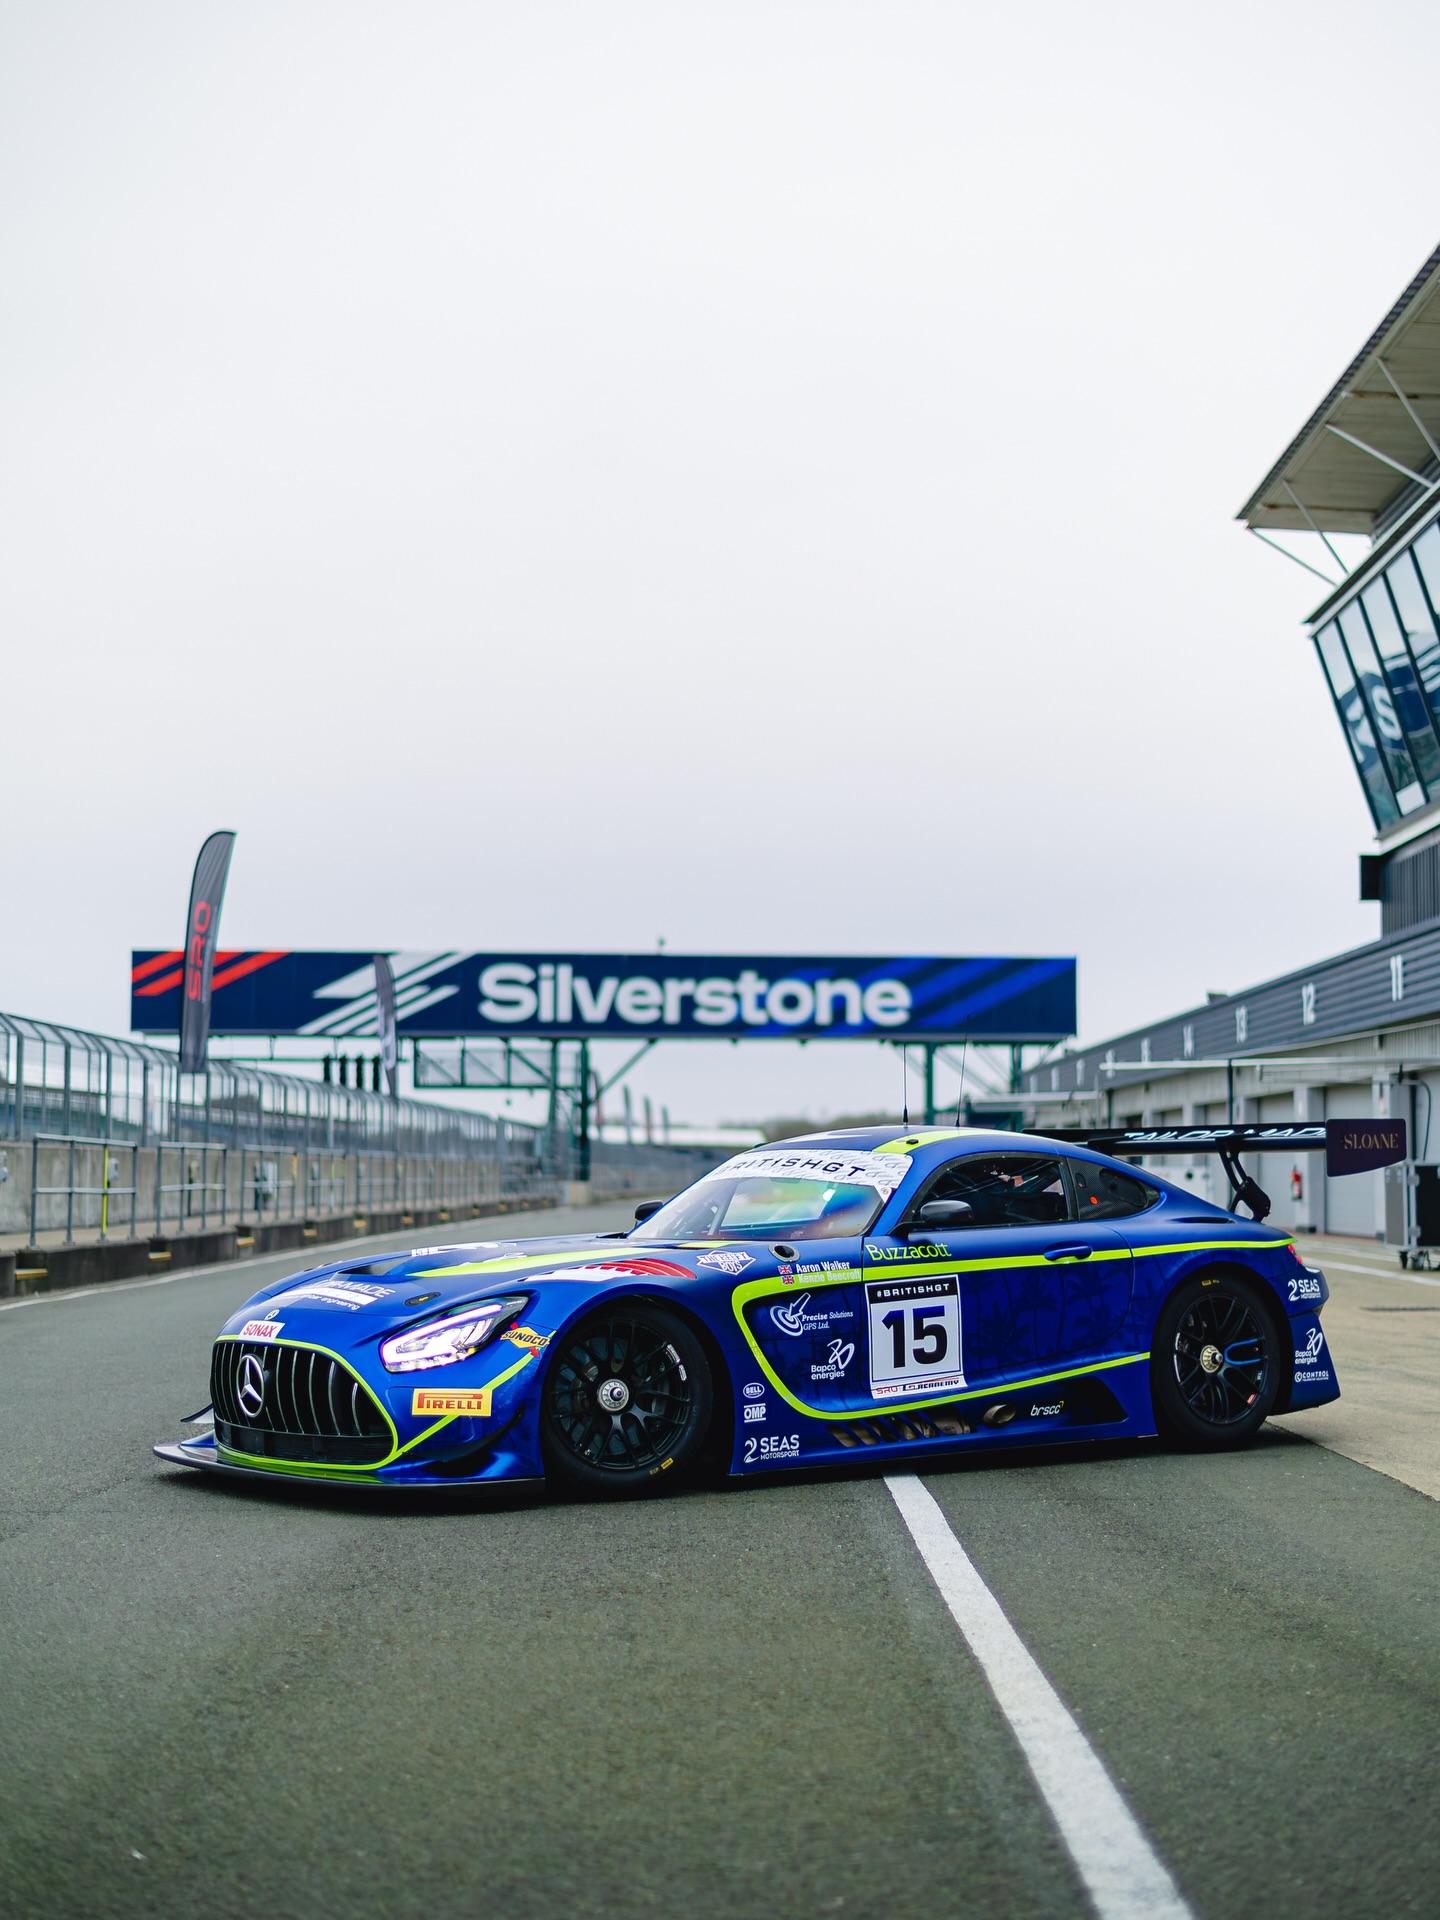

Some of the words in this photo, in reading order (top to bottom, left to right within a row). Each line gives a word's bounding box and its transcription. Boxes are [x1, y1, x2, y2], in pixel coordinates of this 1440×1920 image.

[187, 901, 212, 1000] SRO
[1390, 955, 1403, 1001] 11
[478, 963, 912, 1027] Silverstone
[1302, 983, 1316, 1025] 12
[1236, 1006, 1248, 1043] 13
[1343, 1133, 1399, 1149] SLOANE
[865, 1244, 952, 1261] Buzzacott
[795, 1263, 821, 1274] Aaron
[822, 1261, 851, 1271] Walker
[877, 1283, 950, 1298] #BRITISHGT
[1298, 1279, 1320, 1293] SEAS
[801, 1312, 827, 1322] Precise
[829, 1310, 854, 1320] Solutions
[243, 1323, 277, 1338] SONAX
[803, 1322, 817, 1331] GPS
[818, 1320, 830, 1329] Ltd.
[502, 1330, 549, 1347] SUNOCO
[881, 1305, 948, 1369] 15
[811, 1364, 837, 1375] Bapco
[811, 1370, 845, 1380] energies
[745, 1386, 762, 1394] BELL
[417, 1392, 484, 1410] PIRELLI
[743, 1406, 767, 1420] OMP
[743, 1437, 760, 1464] 2
[760, 1434, 800, 1453] SEAS
[760, 1450, 800, 1461] MOTORSPORT
